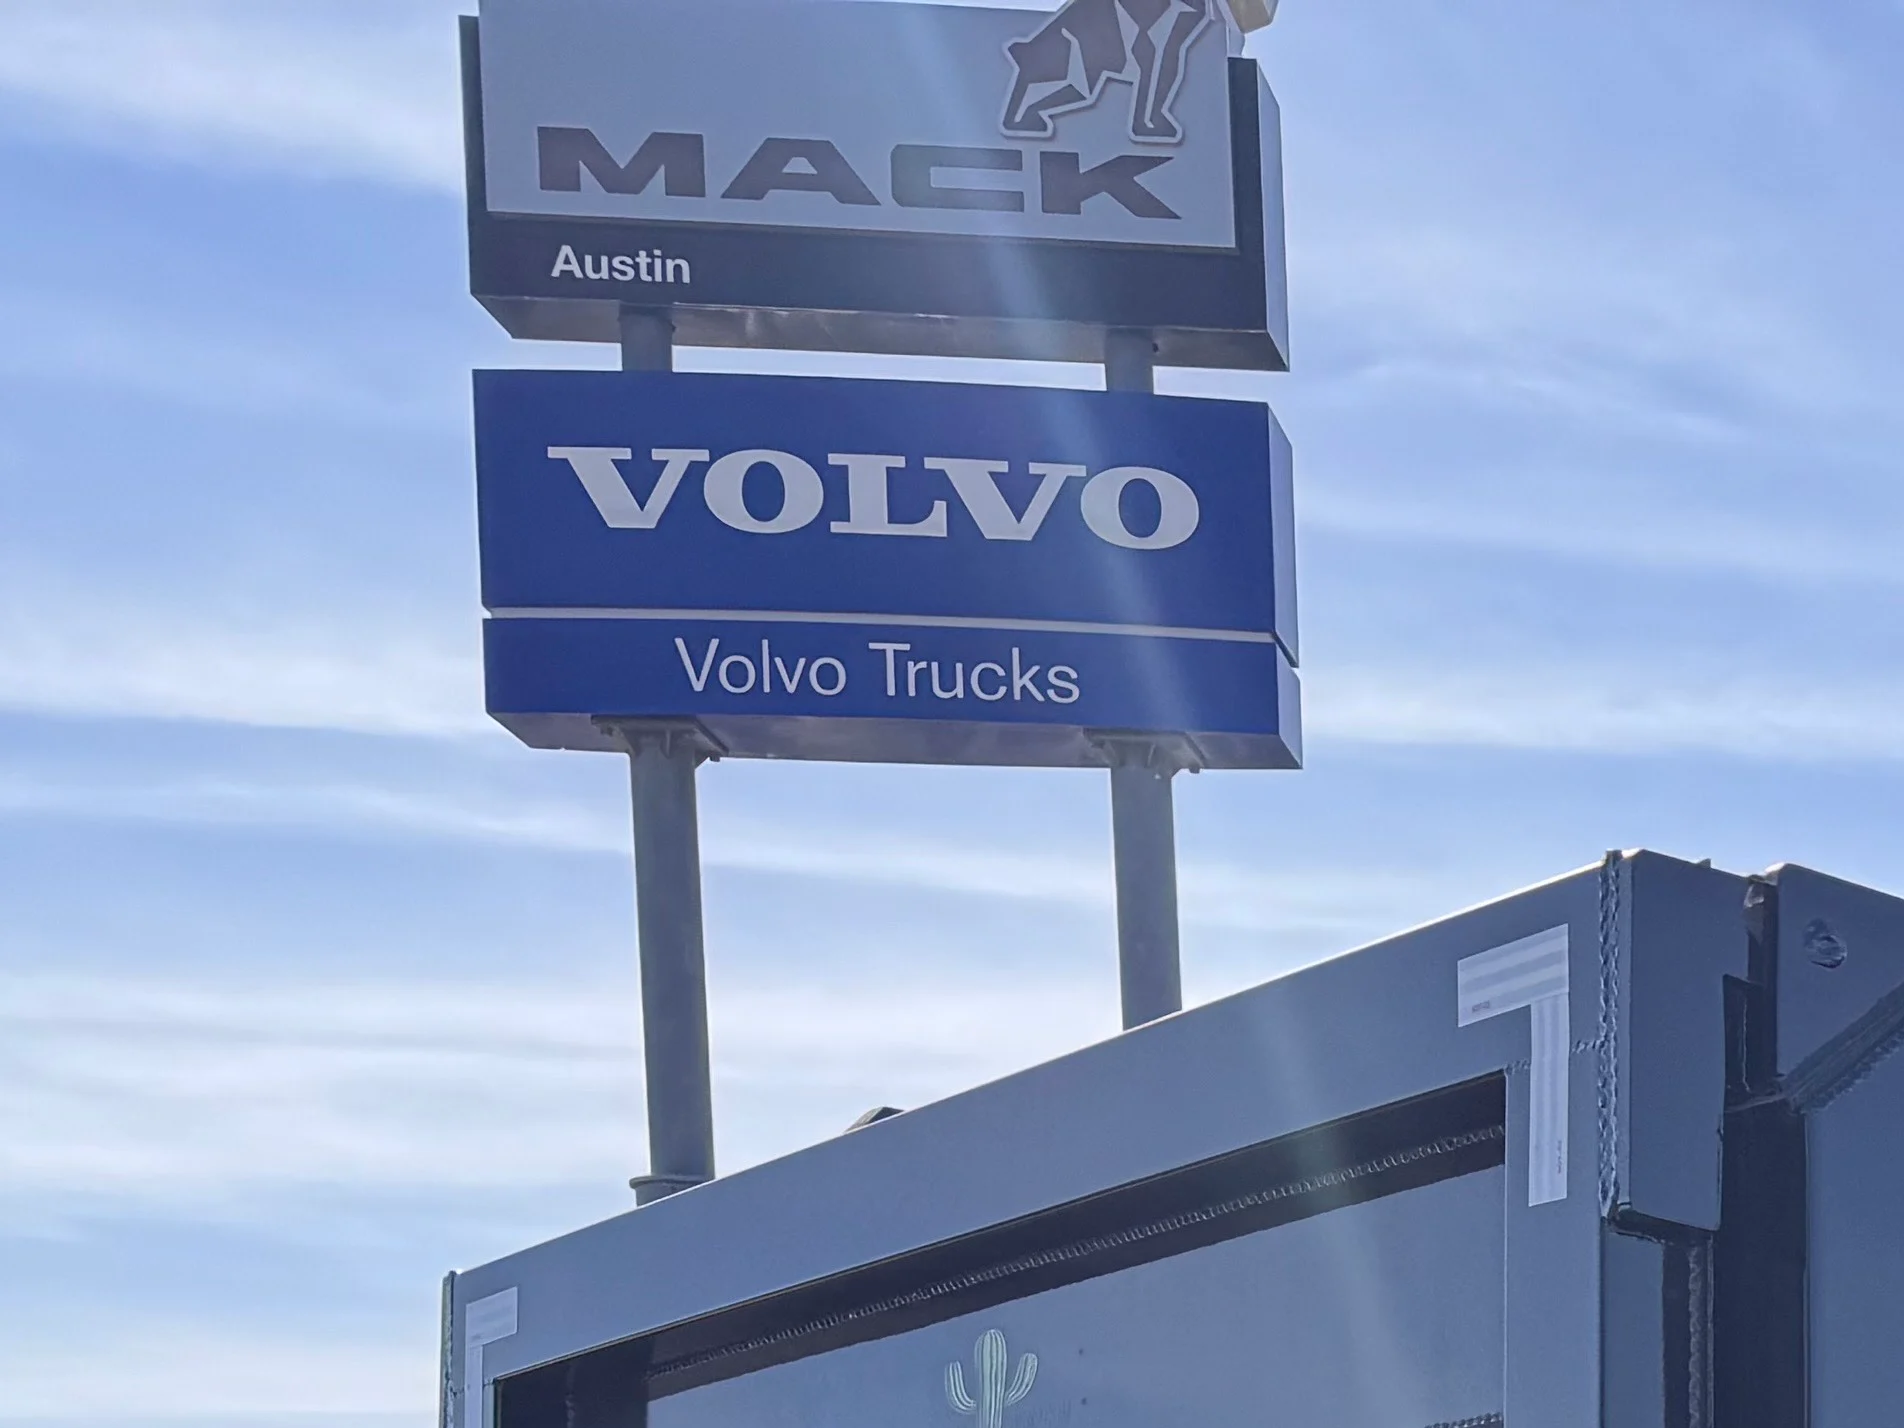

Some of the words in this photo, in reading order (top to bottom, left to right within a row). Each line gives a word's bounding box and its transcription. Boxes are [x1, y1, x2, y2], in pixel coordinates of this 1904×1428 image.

[537, 126, 1181, 220] MACK
[551, 244, 691, 285] Austin
[548, 446, 1200, 550] VOLVO
[674, 637, 847, 697] Volvo
[868, 642, 1081, 705] Trucks
